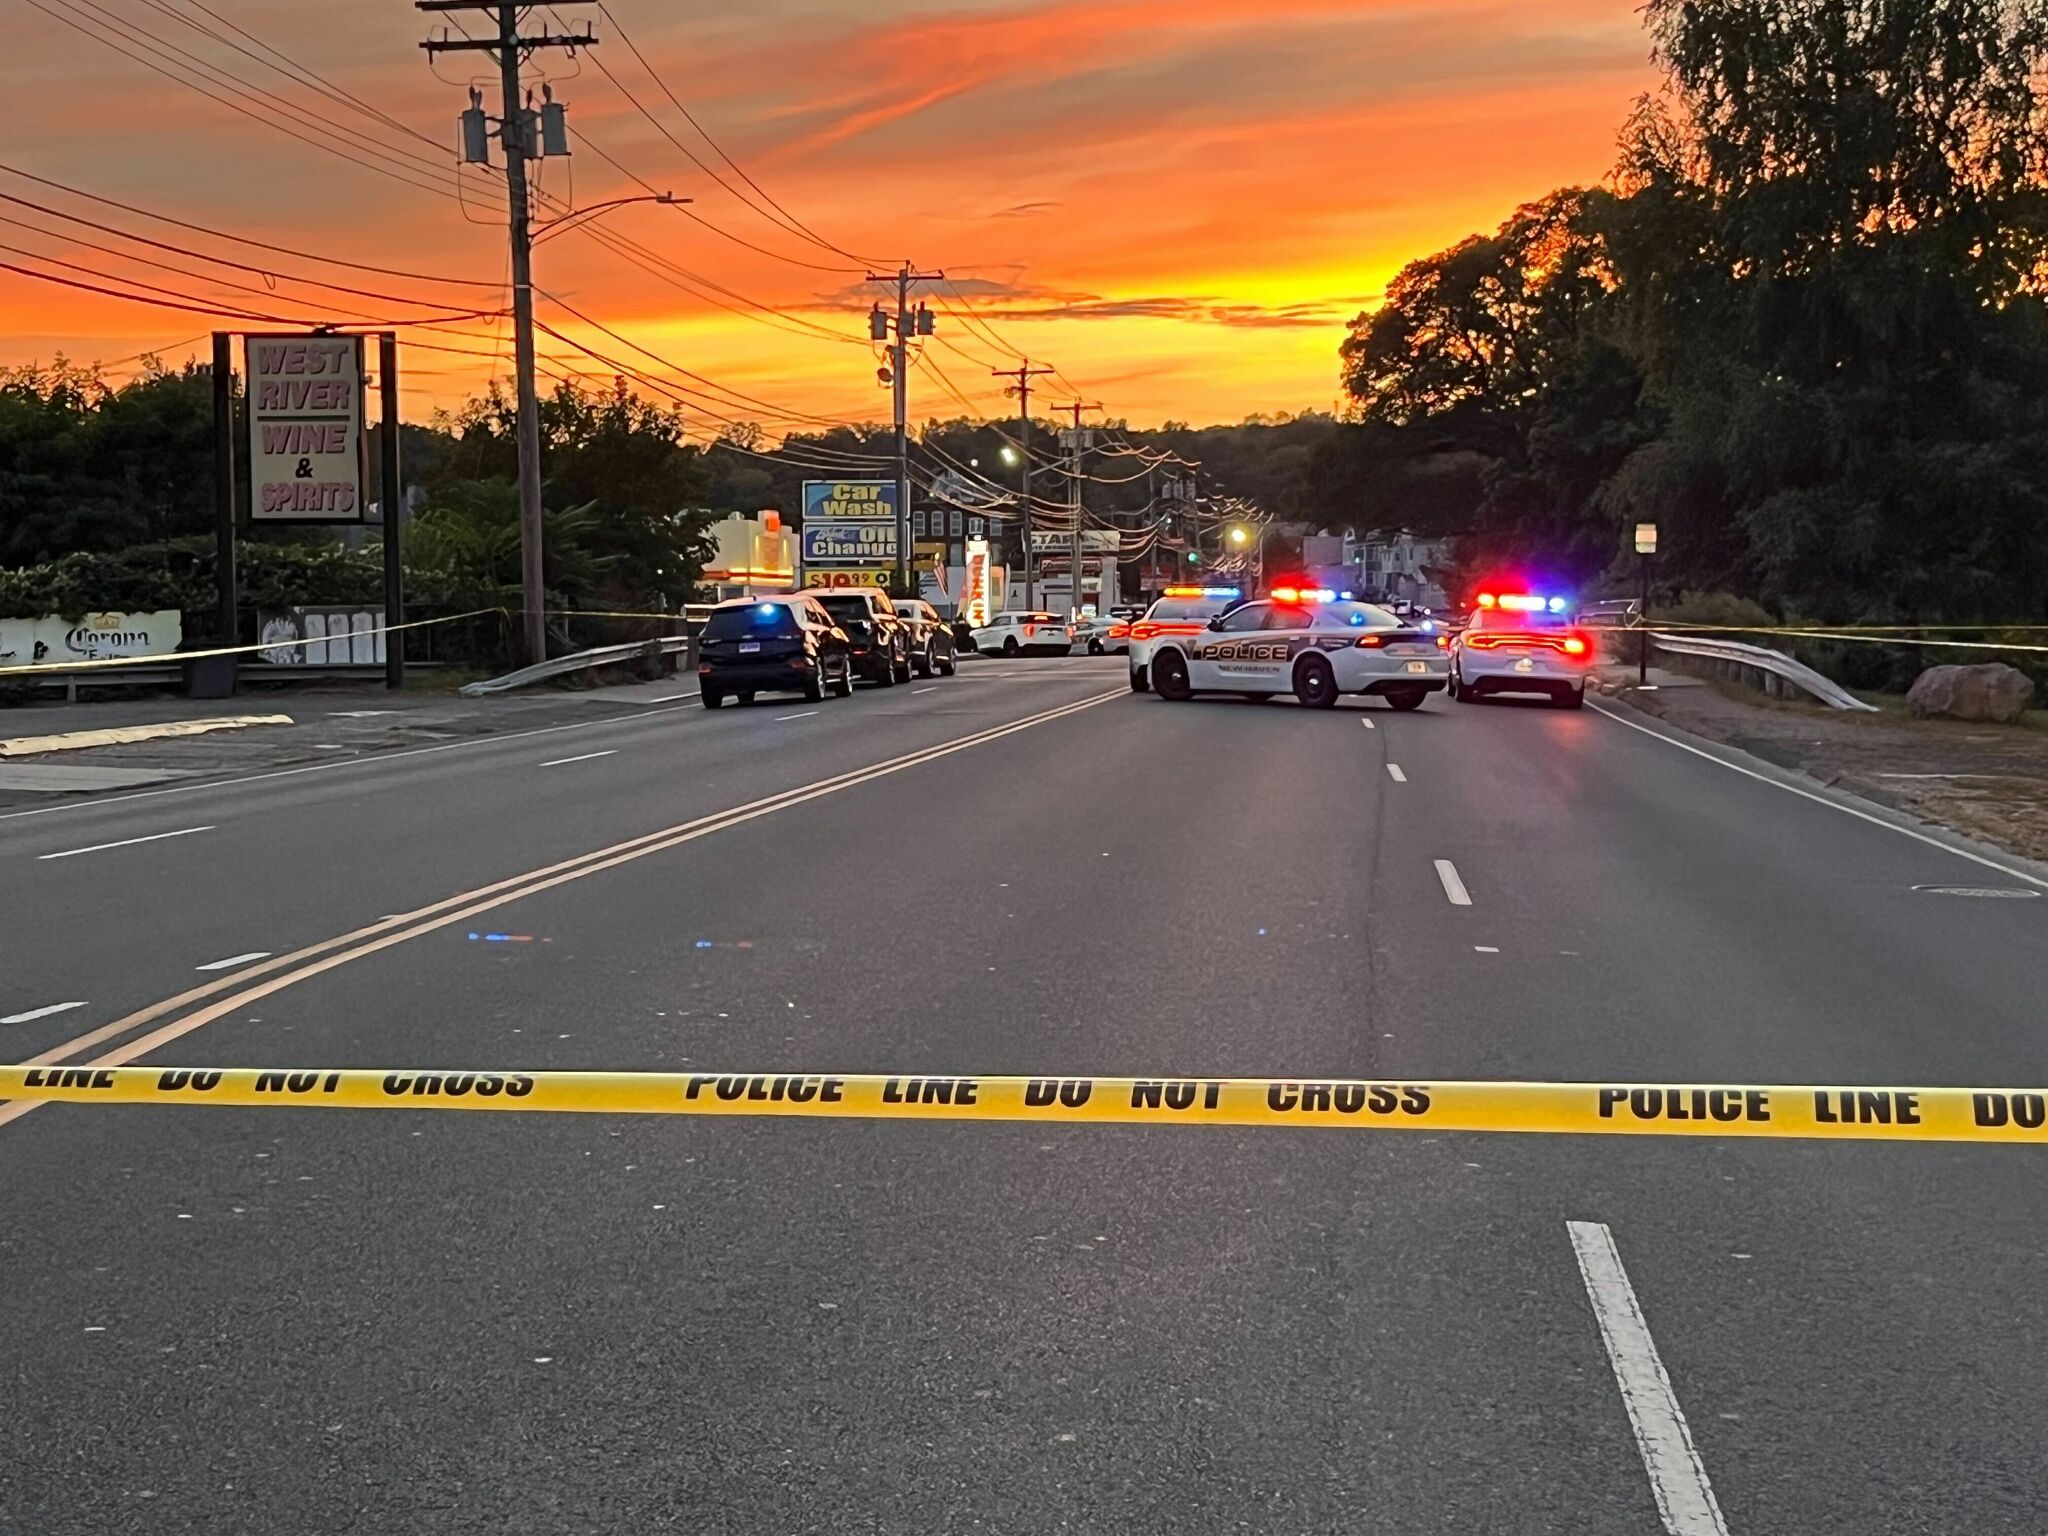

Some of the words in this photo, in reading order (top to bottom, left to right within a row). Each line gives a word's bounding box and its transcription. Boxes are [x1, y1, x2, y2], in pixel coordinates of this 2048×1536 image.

[258, 345, 349, 375] WEST
[258, 380, 350, 410] RIVER
[262, 425, 347, 455] WINE
[295, 458, 313, 478] &
[262, 482, 355, 512] SPIRITS
[833, 484, 881, 500] Car
[822, 500, 892, 515] Wash
[65, 627, 150, 655] Corona
[1203, 644, 1288, 660] POLICE
[24, 1069, 117, 1088] LINE
[157, 1070, 223, 1091] DO
[254, 1071, 342, 1093] NOT
[383, 1073, 533, 1097] CROSS
[685, 1076, 844, 1103] POLICE
[882, 1078, 978, 1105] LINE
[1024, 1079, 1092, 1108] DO
[1131, 1081, 1224, 1109] NOT
[1267, 1082, 1431, 1115] CROSS
[1599, 1088, 1771, 1121] POLICE
[1814, 1090, 1921, 1124] LINE
[1973, 1093, 2046, 1129] DO
